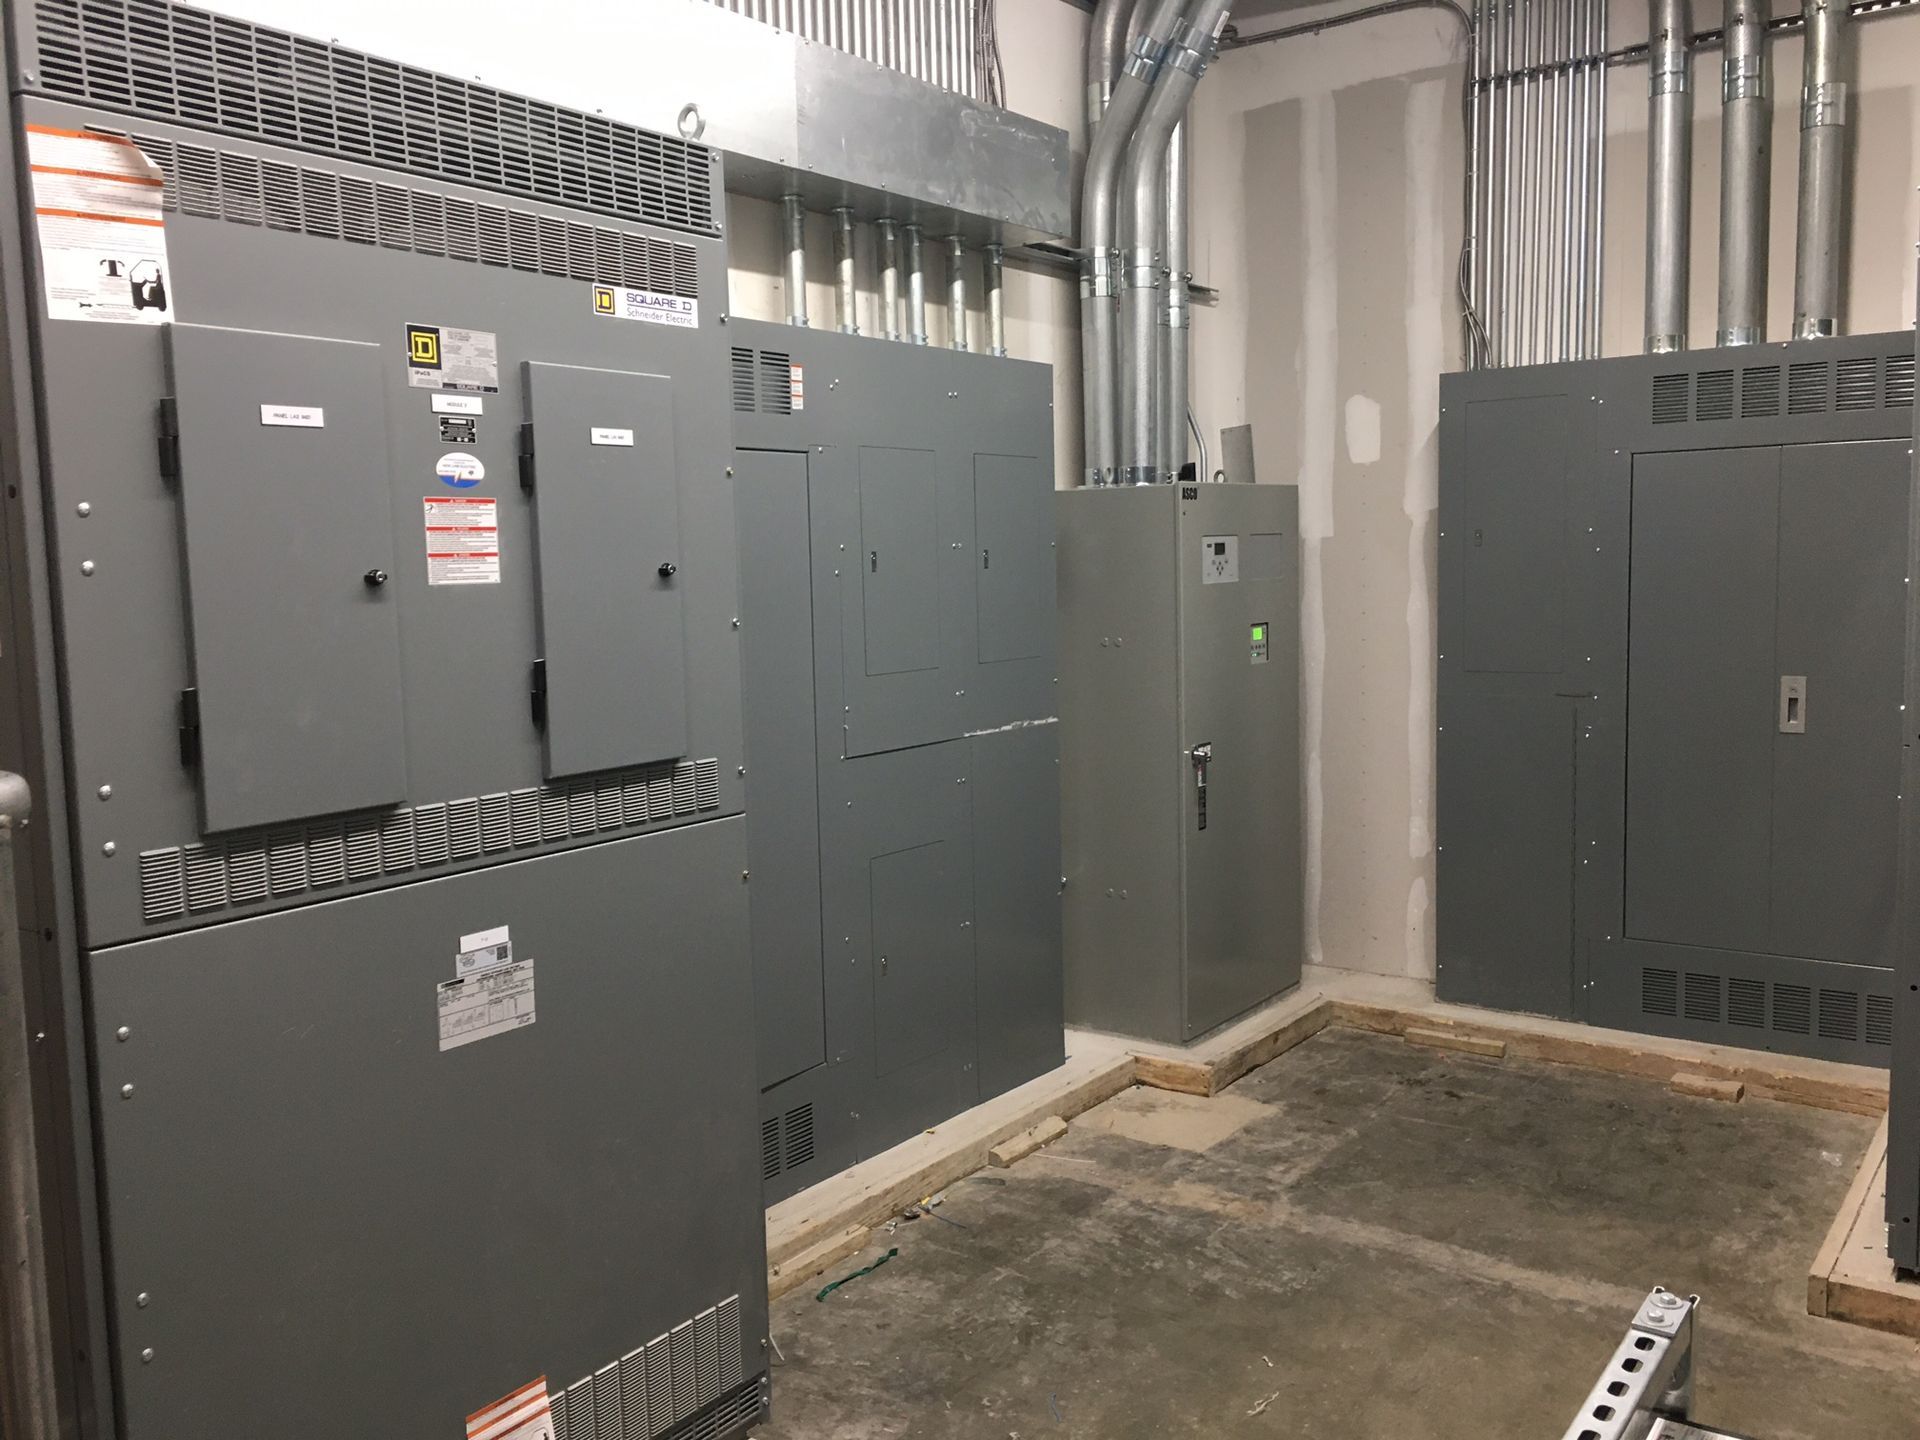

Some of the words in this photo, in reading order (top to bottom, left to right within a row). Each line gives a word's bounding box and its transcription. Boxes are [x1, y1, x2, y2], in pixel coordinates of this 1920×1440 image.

[627, 293, 677, 309] SQUARE
[683, 301, 692, 311] D
[627, 308, 663, 320] Schneider
[666, 314, 692, 325] Electric
[1182, 487, 1197, 500] ASCO
